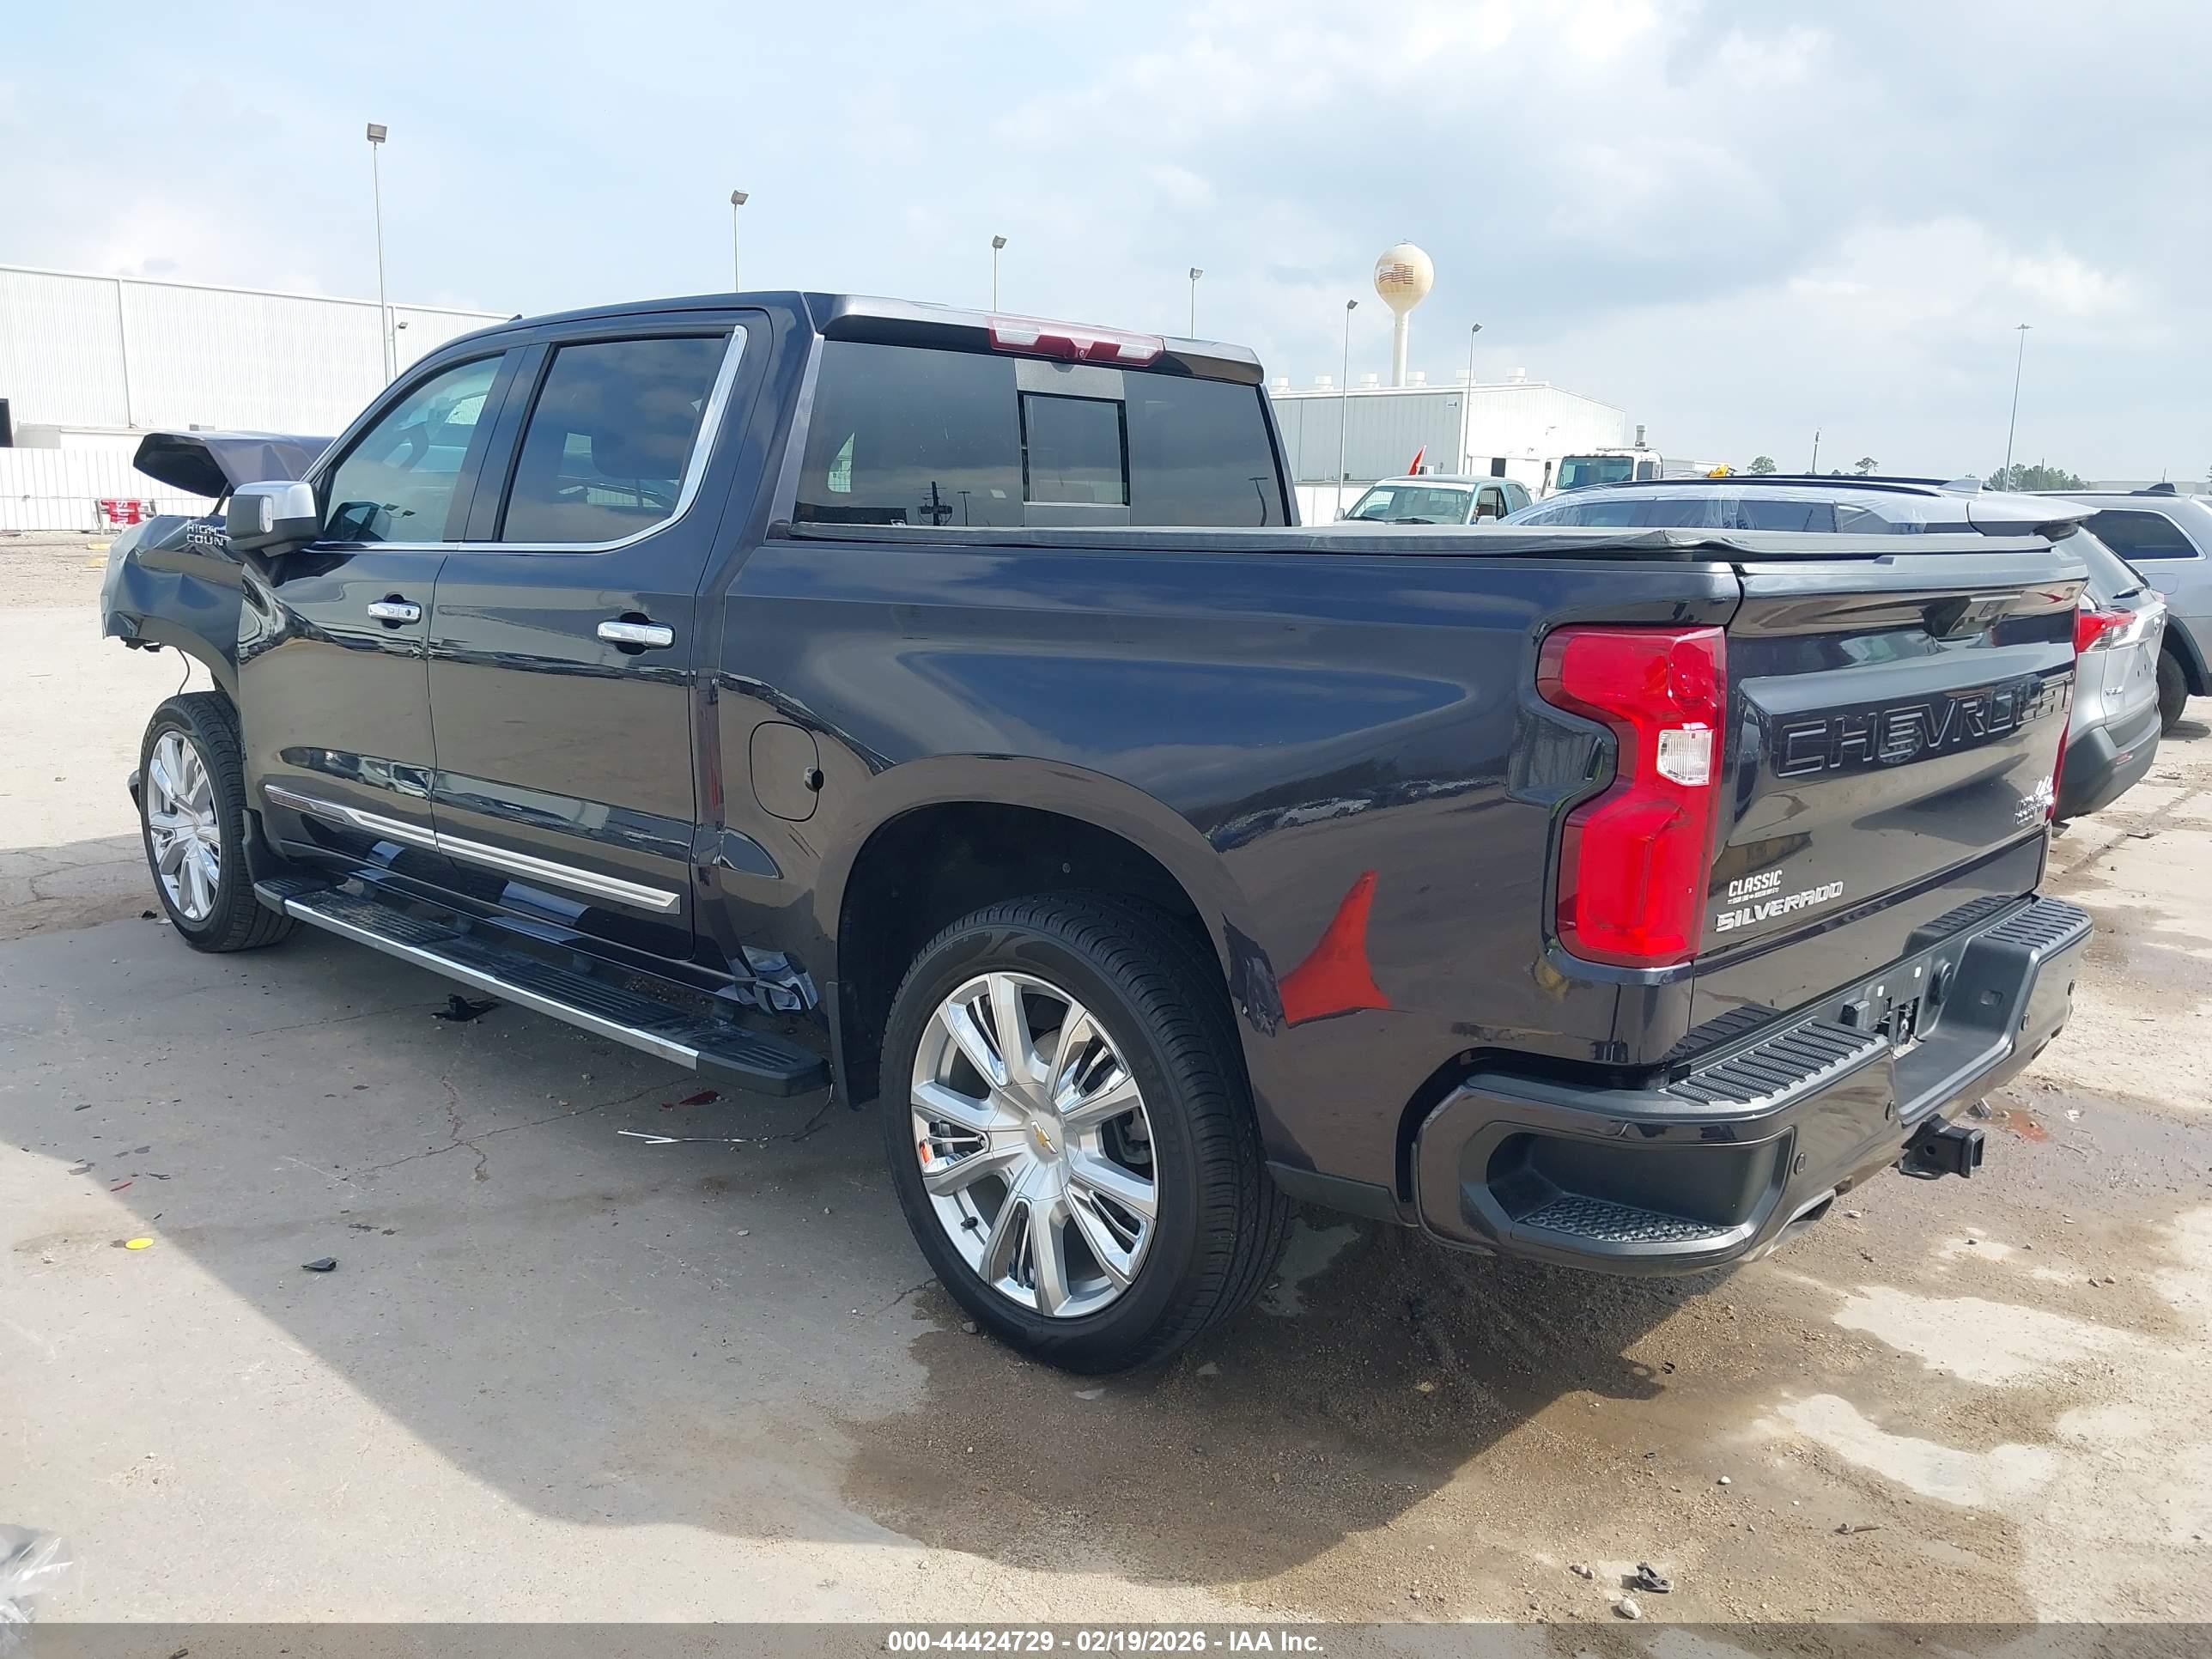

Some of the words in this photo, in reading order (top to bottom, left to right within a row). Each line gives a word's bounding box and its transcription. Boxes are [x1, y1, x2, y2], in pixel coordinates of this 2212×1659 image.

[1775, 670, 2074, 778] CHEVROLET
[1716, 880, 1844, 933] SILVERADO
[1729, 869, 1783, 897] CLASSIC
